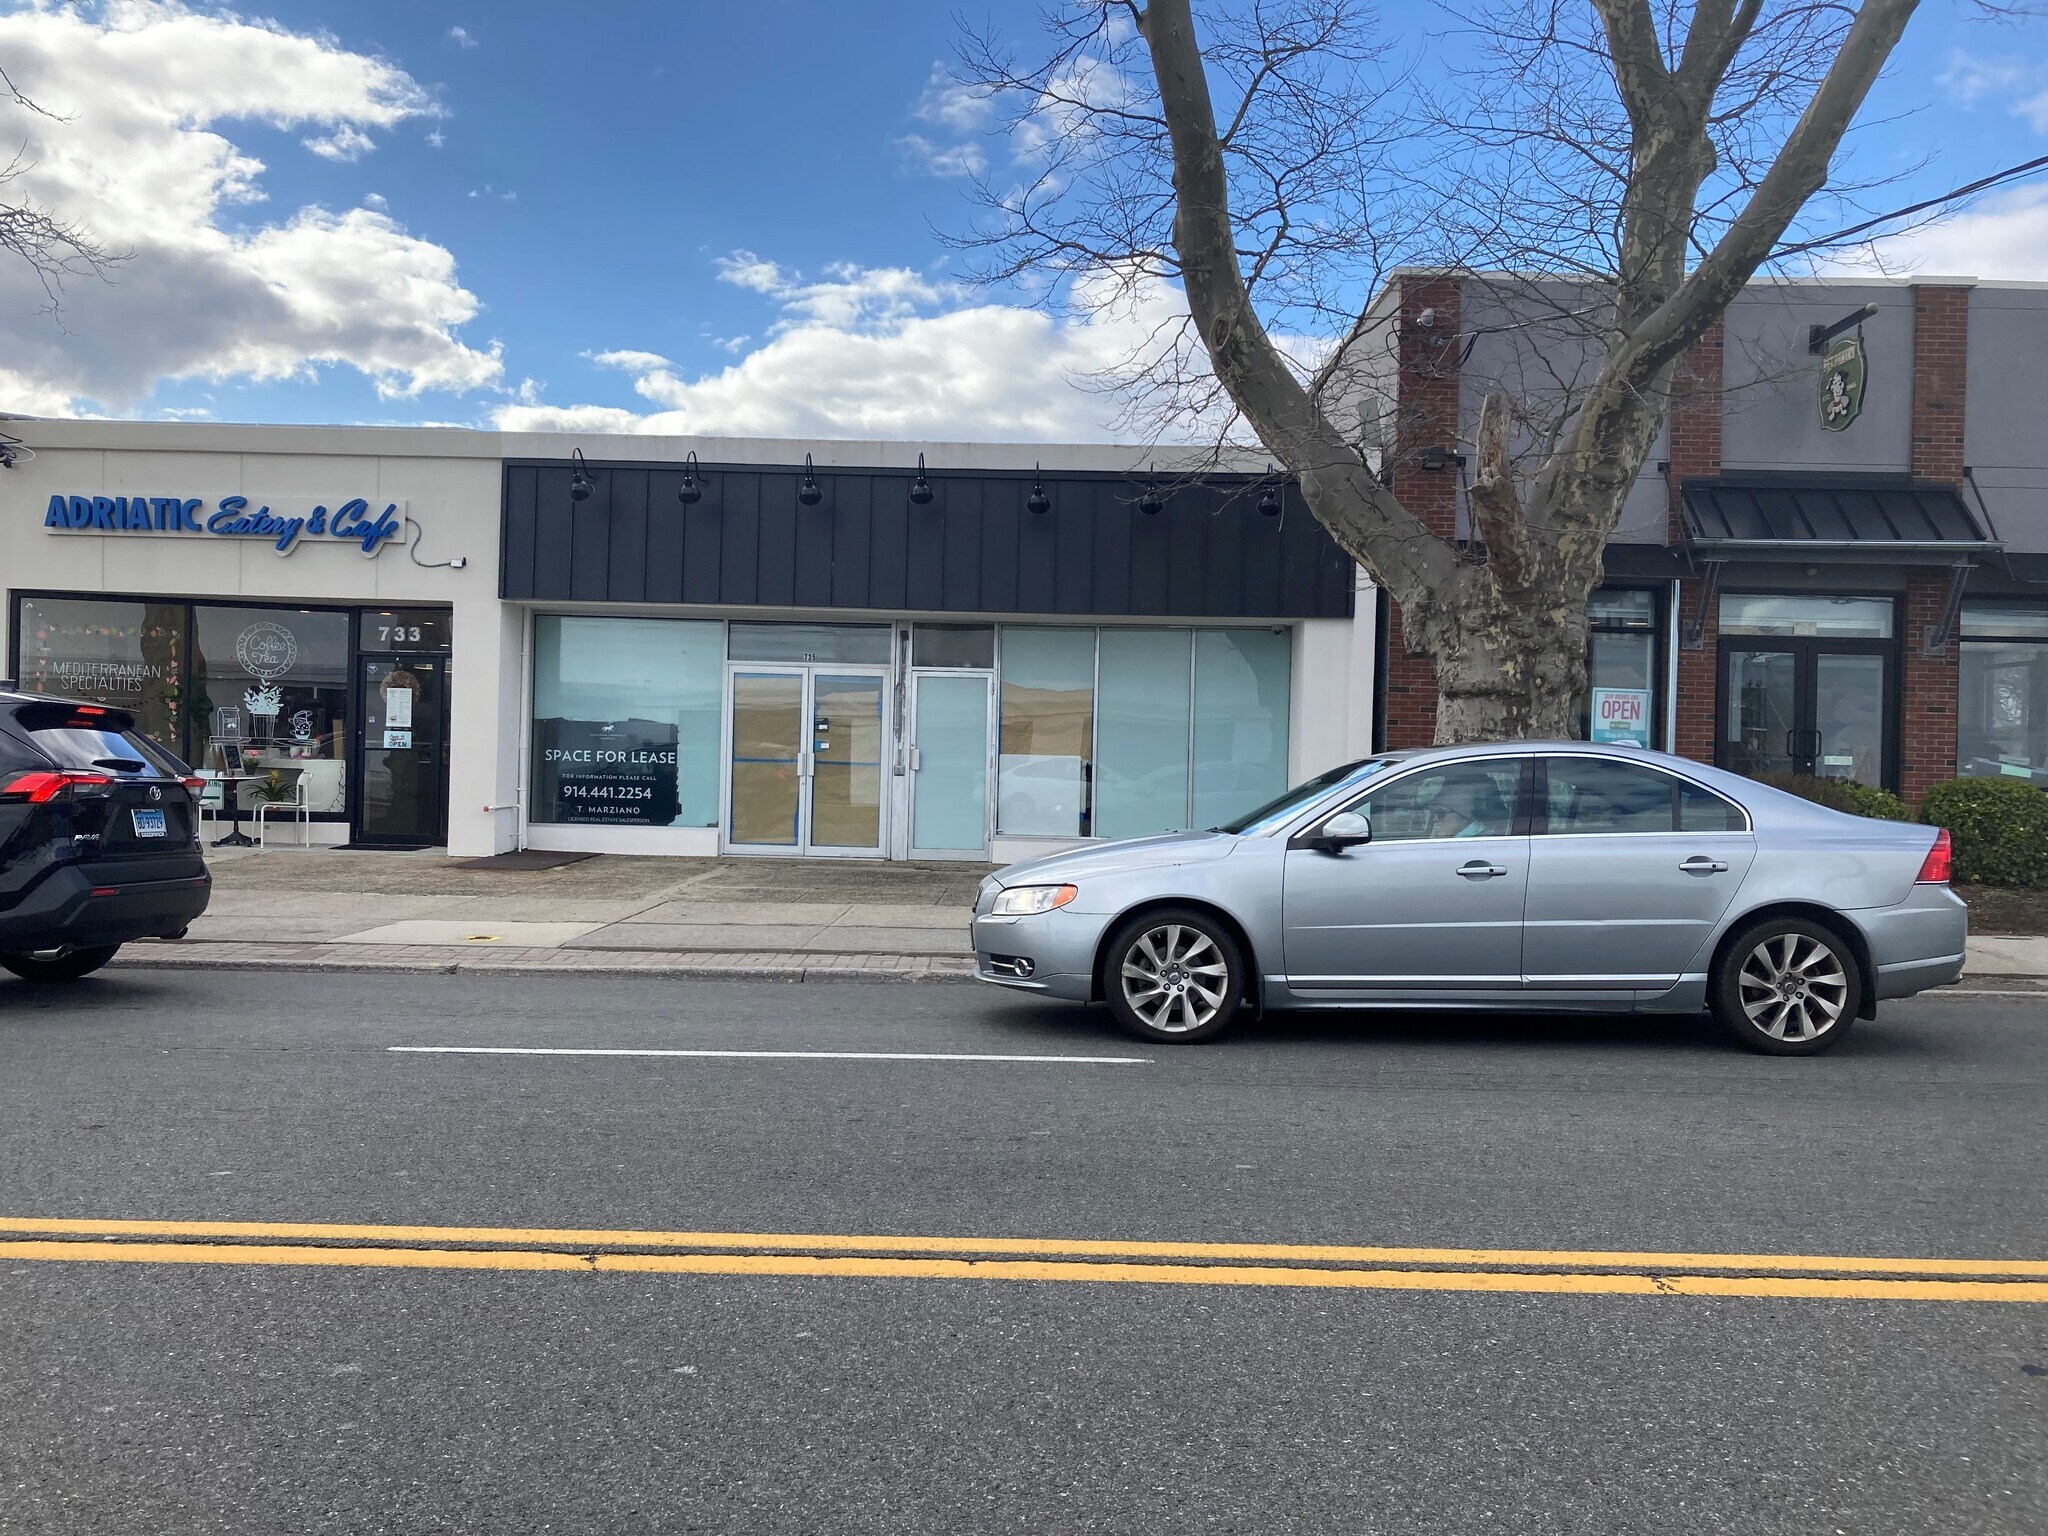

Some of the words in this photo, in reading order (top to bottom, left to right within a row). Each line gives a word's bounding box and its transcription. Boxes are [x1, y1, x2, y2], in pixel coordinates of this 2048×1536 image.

[44, 495, 203, 531] ADRIATIC
[207, 496, 303, 551] Eatery
[307, 506, 325, 534] &
[330, 498, 399, 553] Cafe
[379, 626, 421, 642] 733
[250, 635, 286, 651] Coffee
[252, 652, 278, 664] Tea
[804, 653, 816, 661] 735
[53, 661, 161, 678] MEDITERRANEAN
[61, 675, 142, 692] SPECIALTIES
[1601, 700, 1640, 720] OPEN
[545, 749, 591, 761] SPACE
[596, 750, 626, 763] FOR
[632, 751, 676, 764] LEASE
[563, 785, 652, 799] 914.441.2254
[577, 805, 585, 813] T.
[589, 806, 640, 814] MARZIANO
